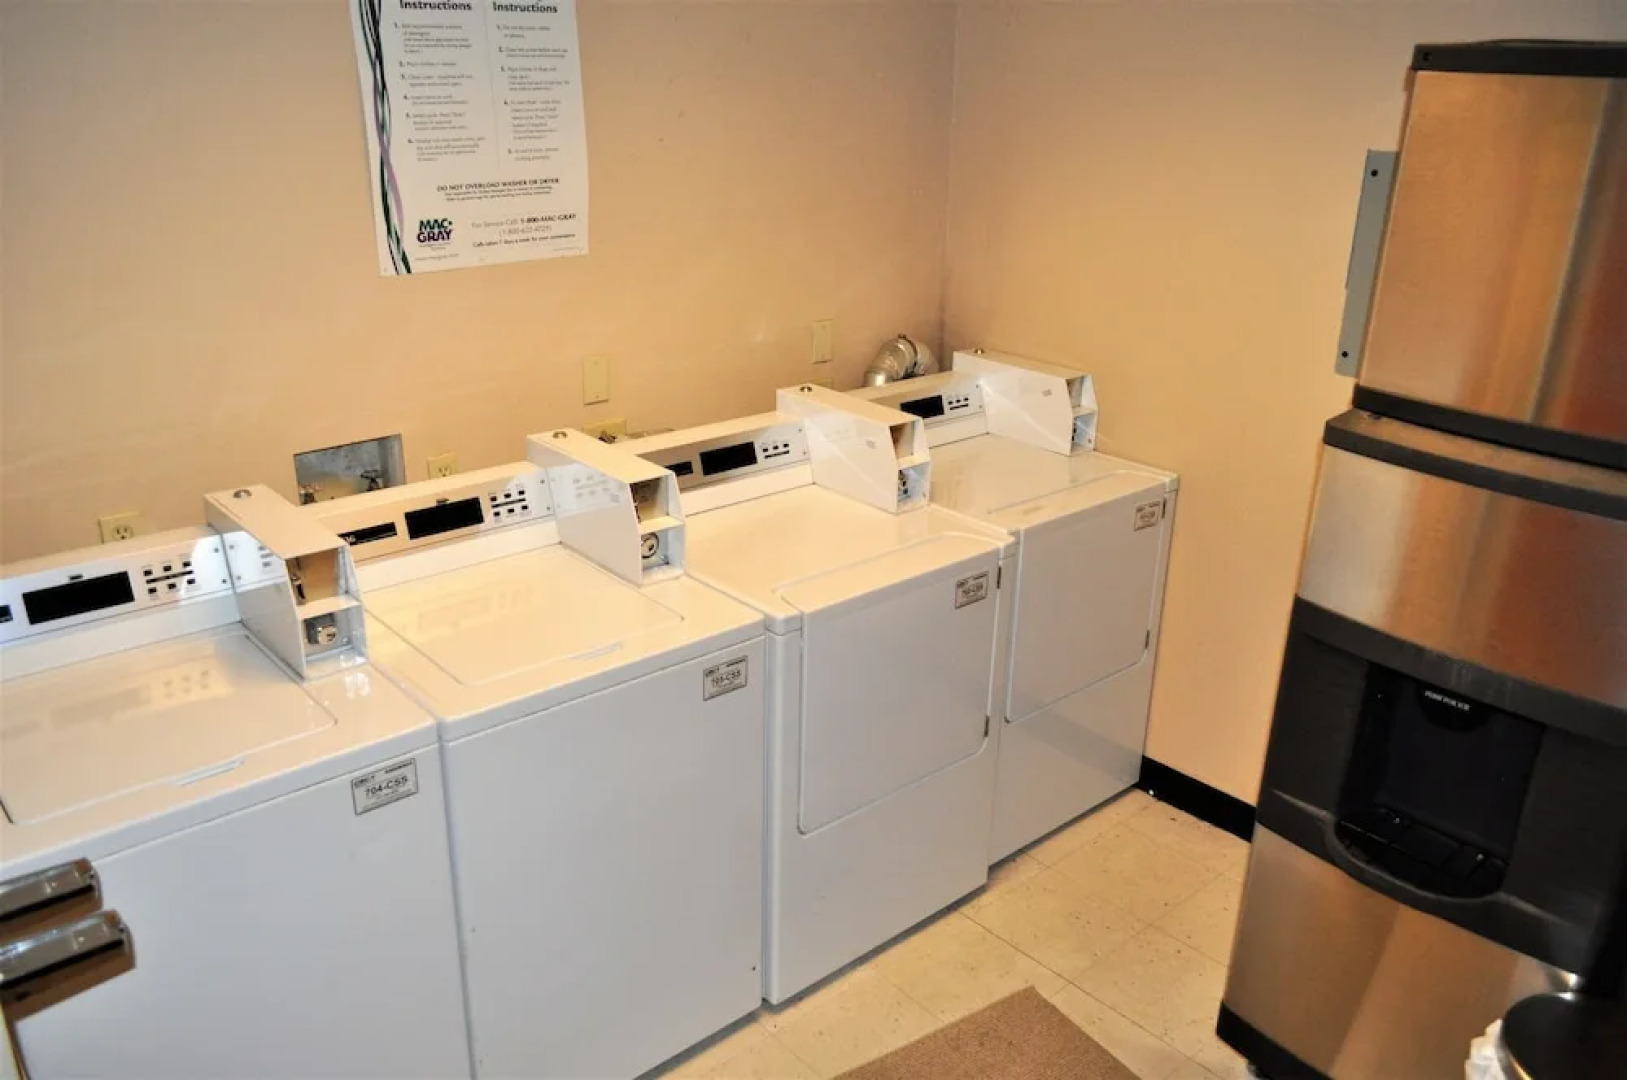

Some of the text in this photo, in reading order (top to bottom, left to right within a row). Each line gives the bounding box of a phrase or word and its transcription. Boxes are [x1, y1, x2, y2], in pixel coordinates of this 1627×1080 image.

[400, 0, 473, 11] Instructions
[493, 1, 558, 14] Instructions
[449, 183, 463, 191] NOT
[465, 181, 499, 190] OVERLOAD
[501, 179, 527, 188] WASHER
[539, 176, 560, 185] DRYER
[417, 228, 453, 242] GRAY
